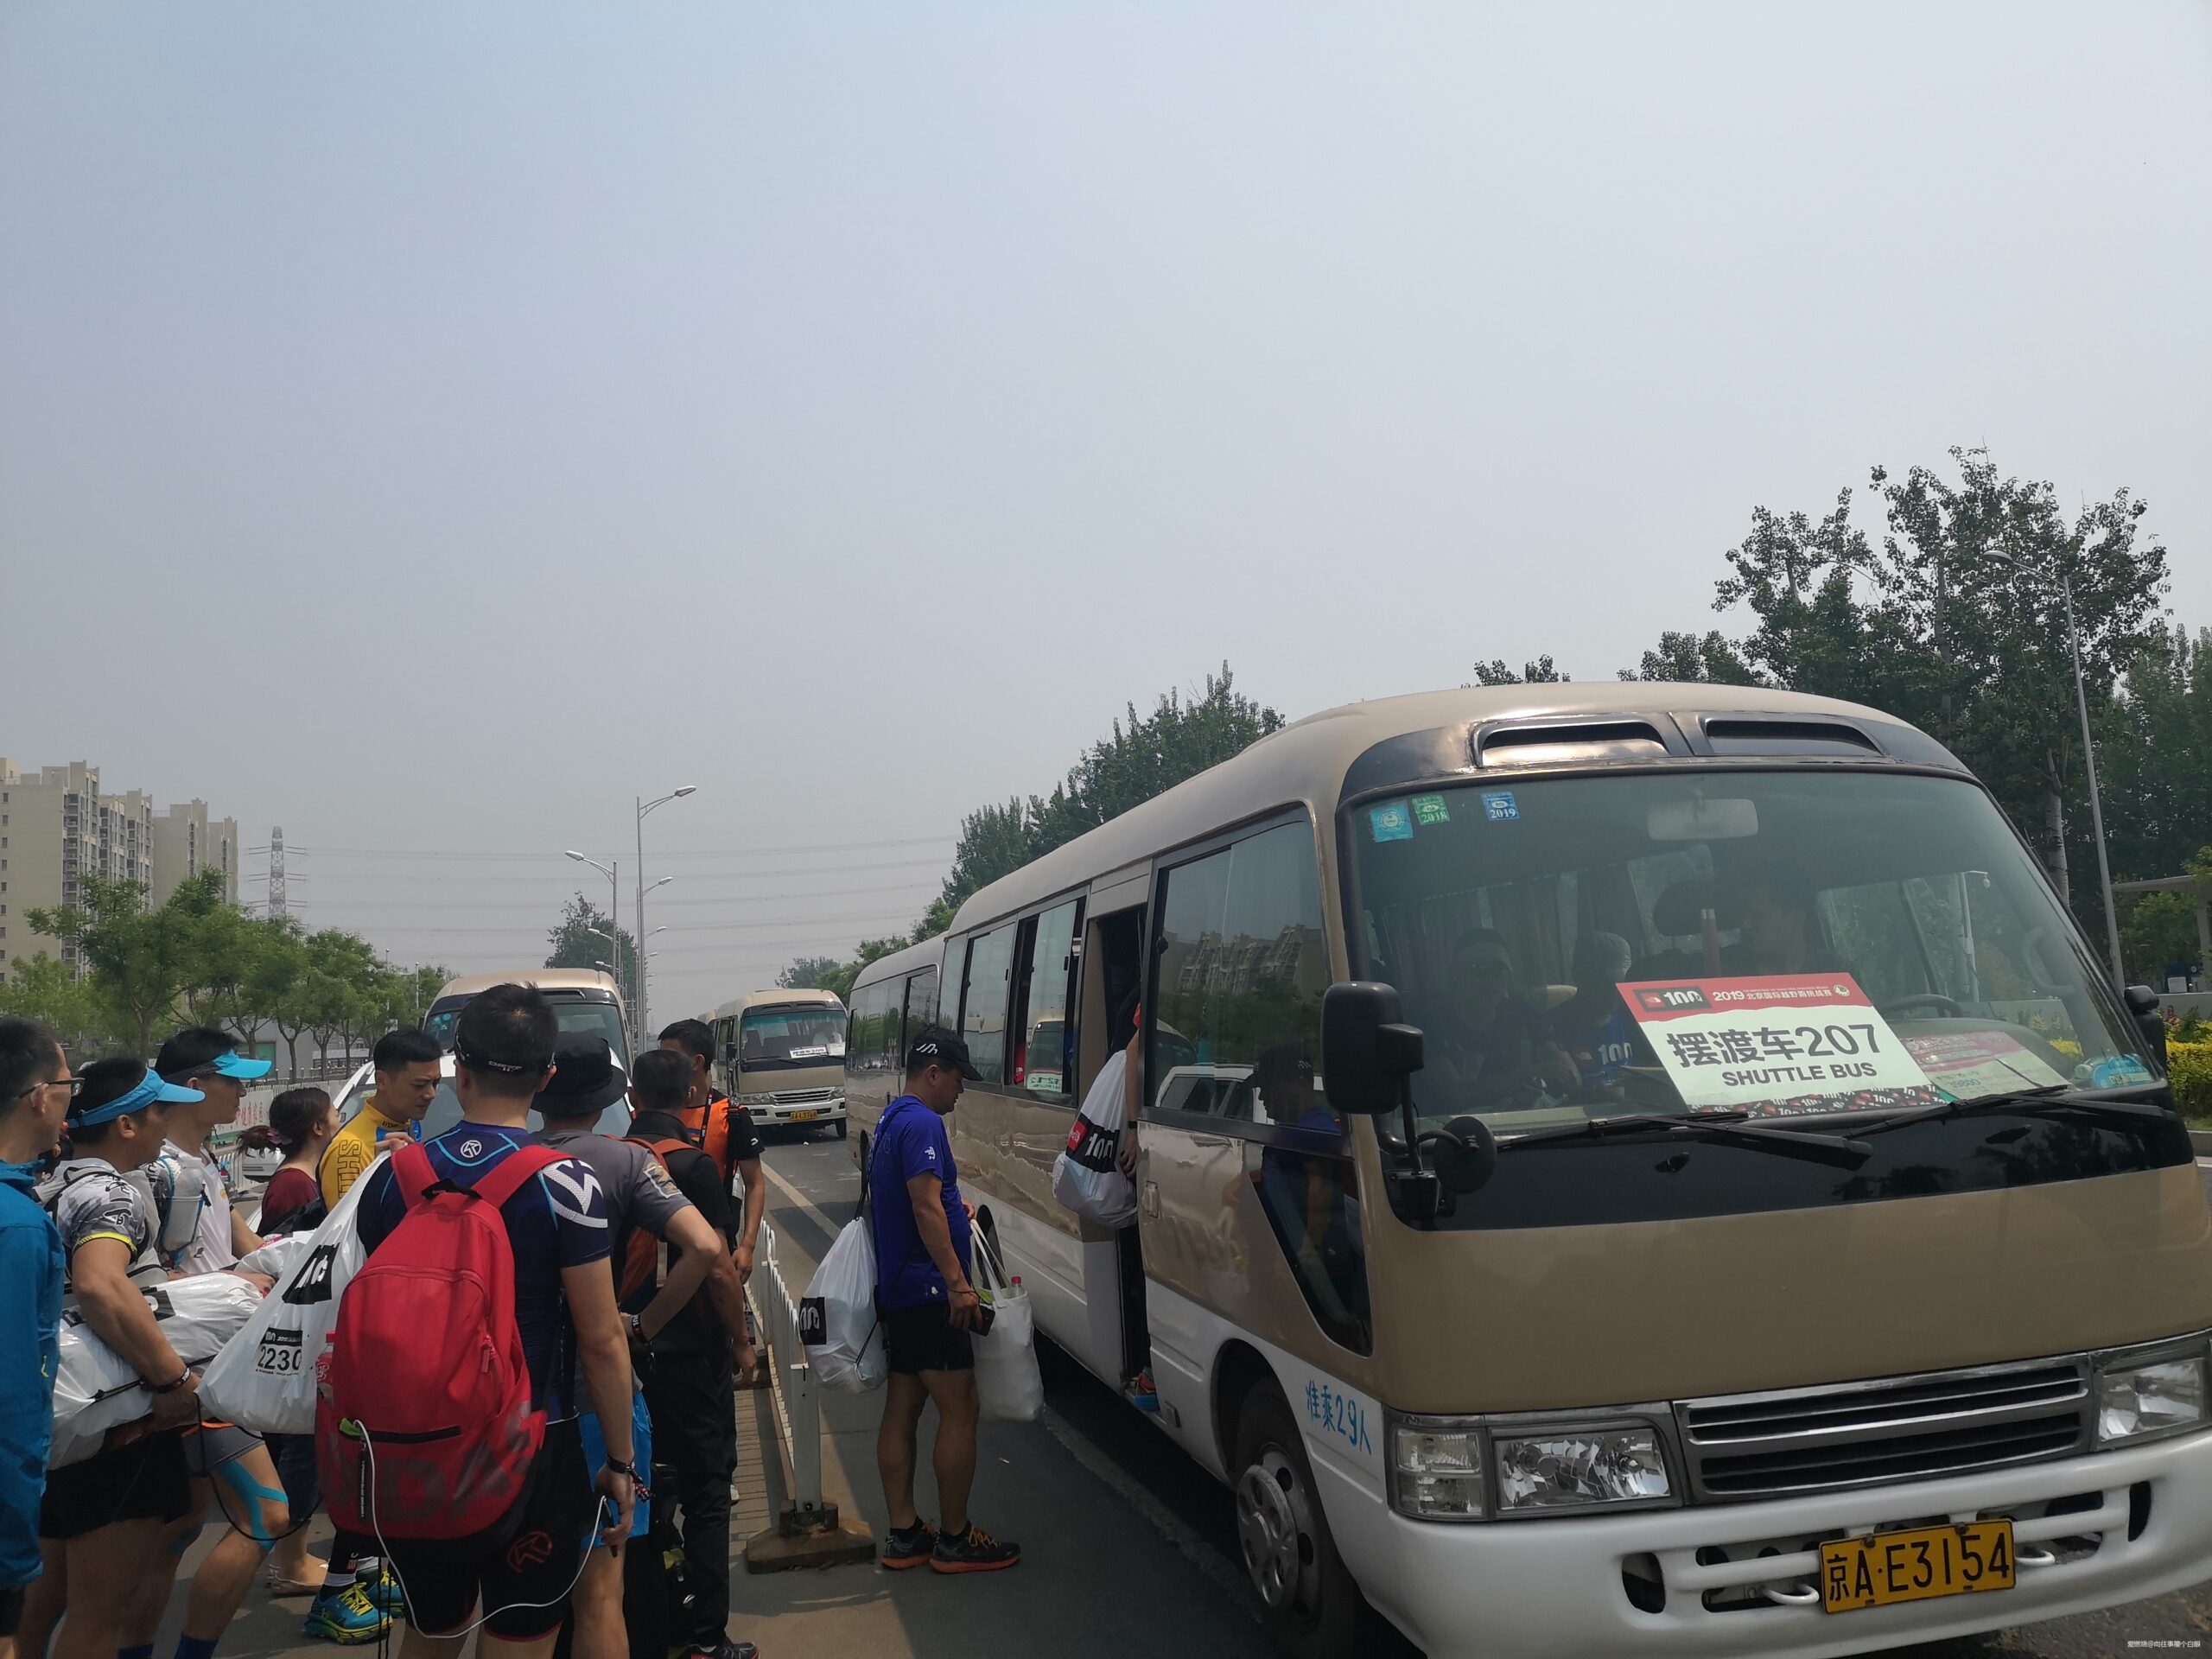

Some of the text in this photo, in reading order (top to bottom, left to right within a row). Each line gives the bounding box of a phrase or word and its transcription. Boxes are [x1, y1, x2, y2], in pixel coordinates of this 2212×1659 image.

[1421, 810, 1448, 823] 2018
[1489, 807, 1516, 819] 2019
[1713, 990, 1745, 1001] 2019
[1667, 1023, 1881, 1068] 摆渡车207
[1722, 1062, 1878, 1087] SHUTTLE BUS
[257, 1346, 302, 1371] 2230
[1306, 1380, 1372, 1456] 准乘29人
